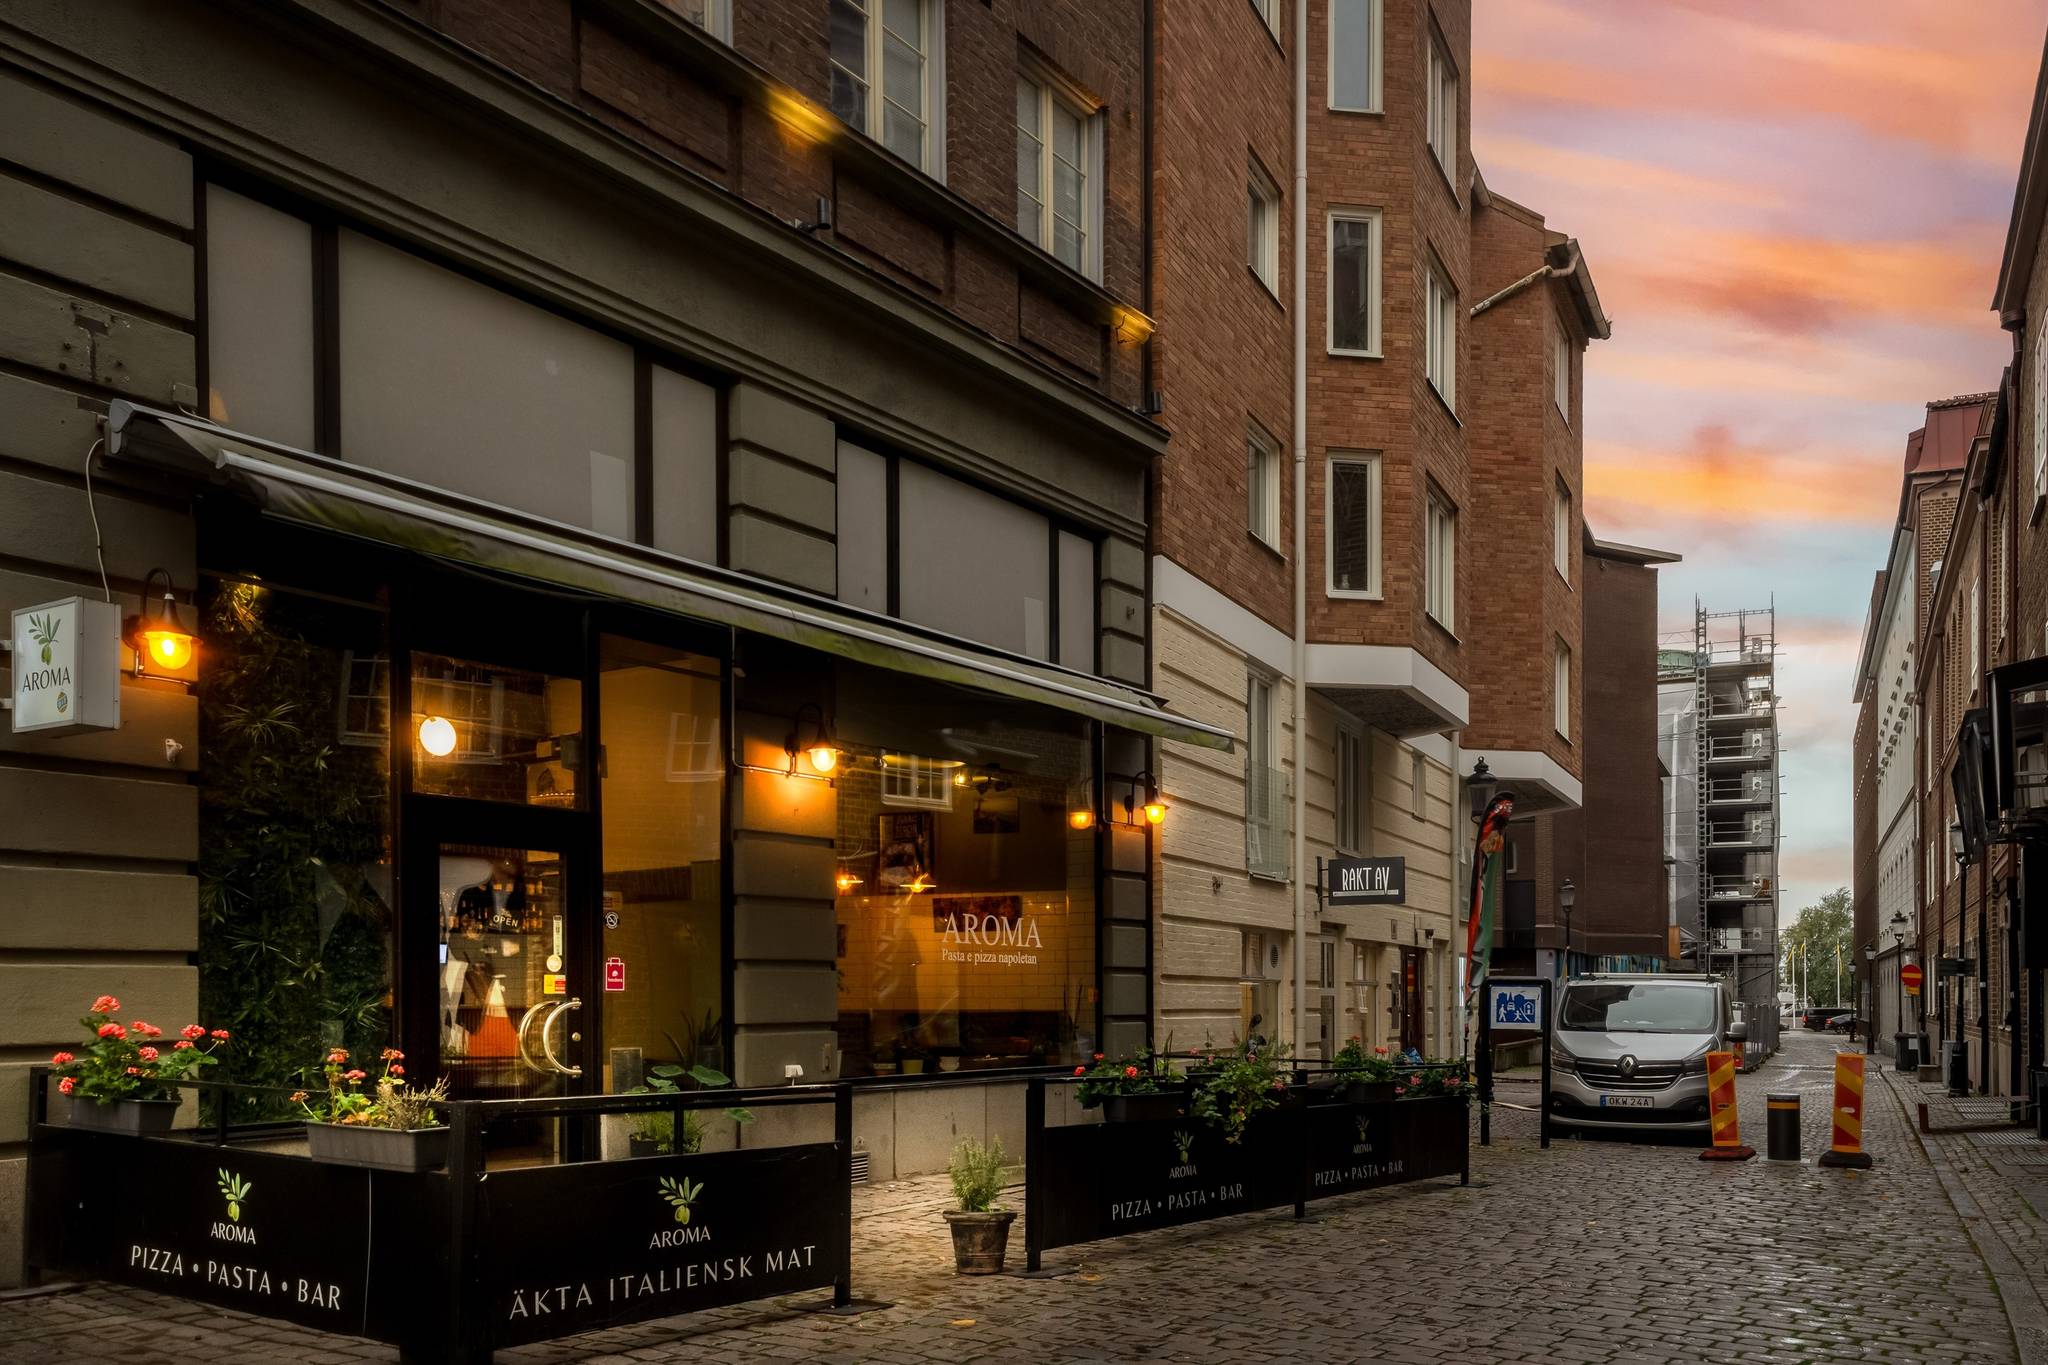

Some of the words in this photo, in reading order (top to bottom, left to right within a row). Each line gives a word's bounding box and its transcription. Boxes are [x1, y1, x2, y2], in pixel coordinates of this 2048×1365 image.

[22, 665, 71, 692] AROMA
[1342, 867, 1372, 891] RAKT
[1375, 866, 1390, 895] AV
[493, 914, 519, 927] OPEN
[942, 912, 1043, 948] AROMA
[942, 949, 965, 962] Pasta
[967, 953, 972, 962] e
[975, 950, 997, 965] pizza
[999, 951, 1037, 966] napoletan
[1352, 1143, 1373, 1154] AROMA
[1169, 1163, 1197, 1179] AROMA
[1315, 1170, 1342, 1186] PIZZA
[1351, 1165, 1379, 1181] PASTA
[1389, 1159, 1404, 1174] BAR
[1112, 1199, 1152, 1221] PIZZA
[1168, 1190, 1207, 1211] PASTA
[1220, 1183, 1244, 1201] BAR
[210, 1222, 257, 1245] AROMA
[649, 1225, 711, 1250] AROMA
[130, 1245, 183, 1277] PIZZA
[208, 1260, 271, 1295] PASTA
[298, 1278, 342, 1312] BAR
[509, 1283, 593, 1321] ÄKTA
[609, 1256, 753, 1302] ITALIENSK
[766, 1245, 816, 1273] MAT
